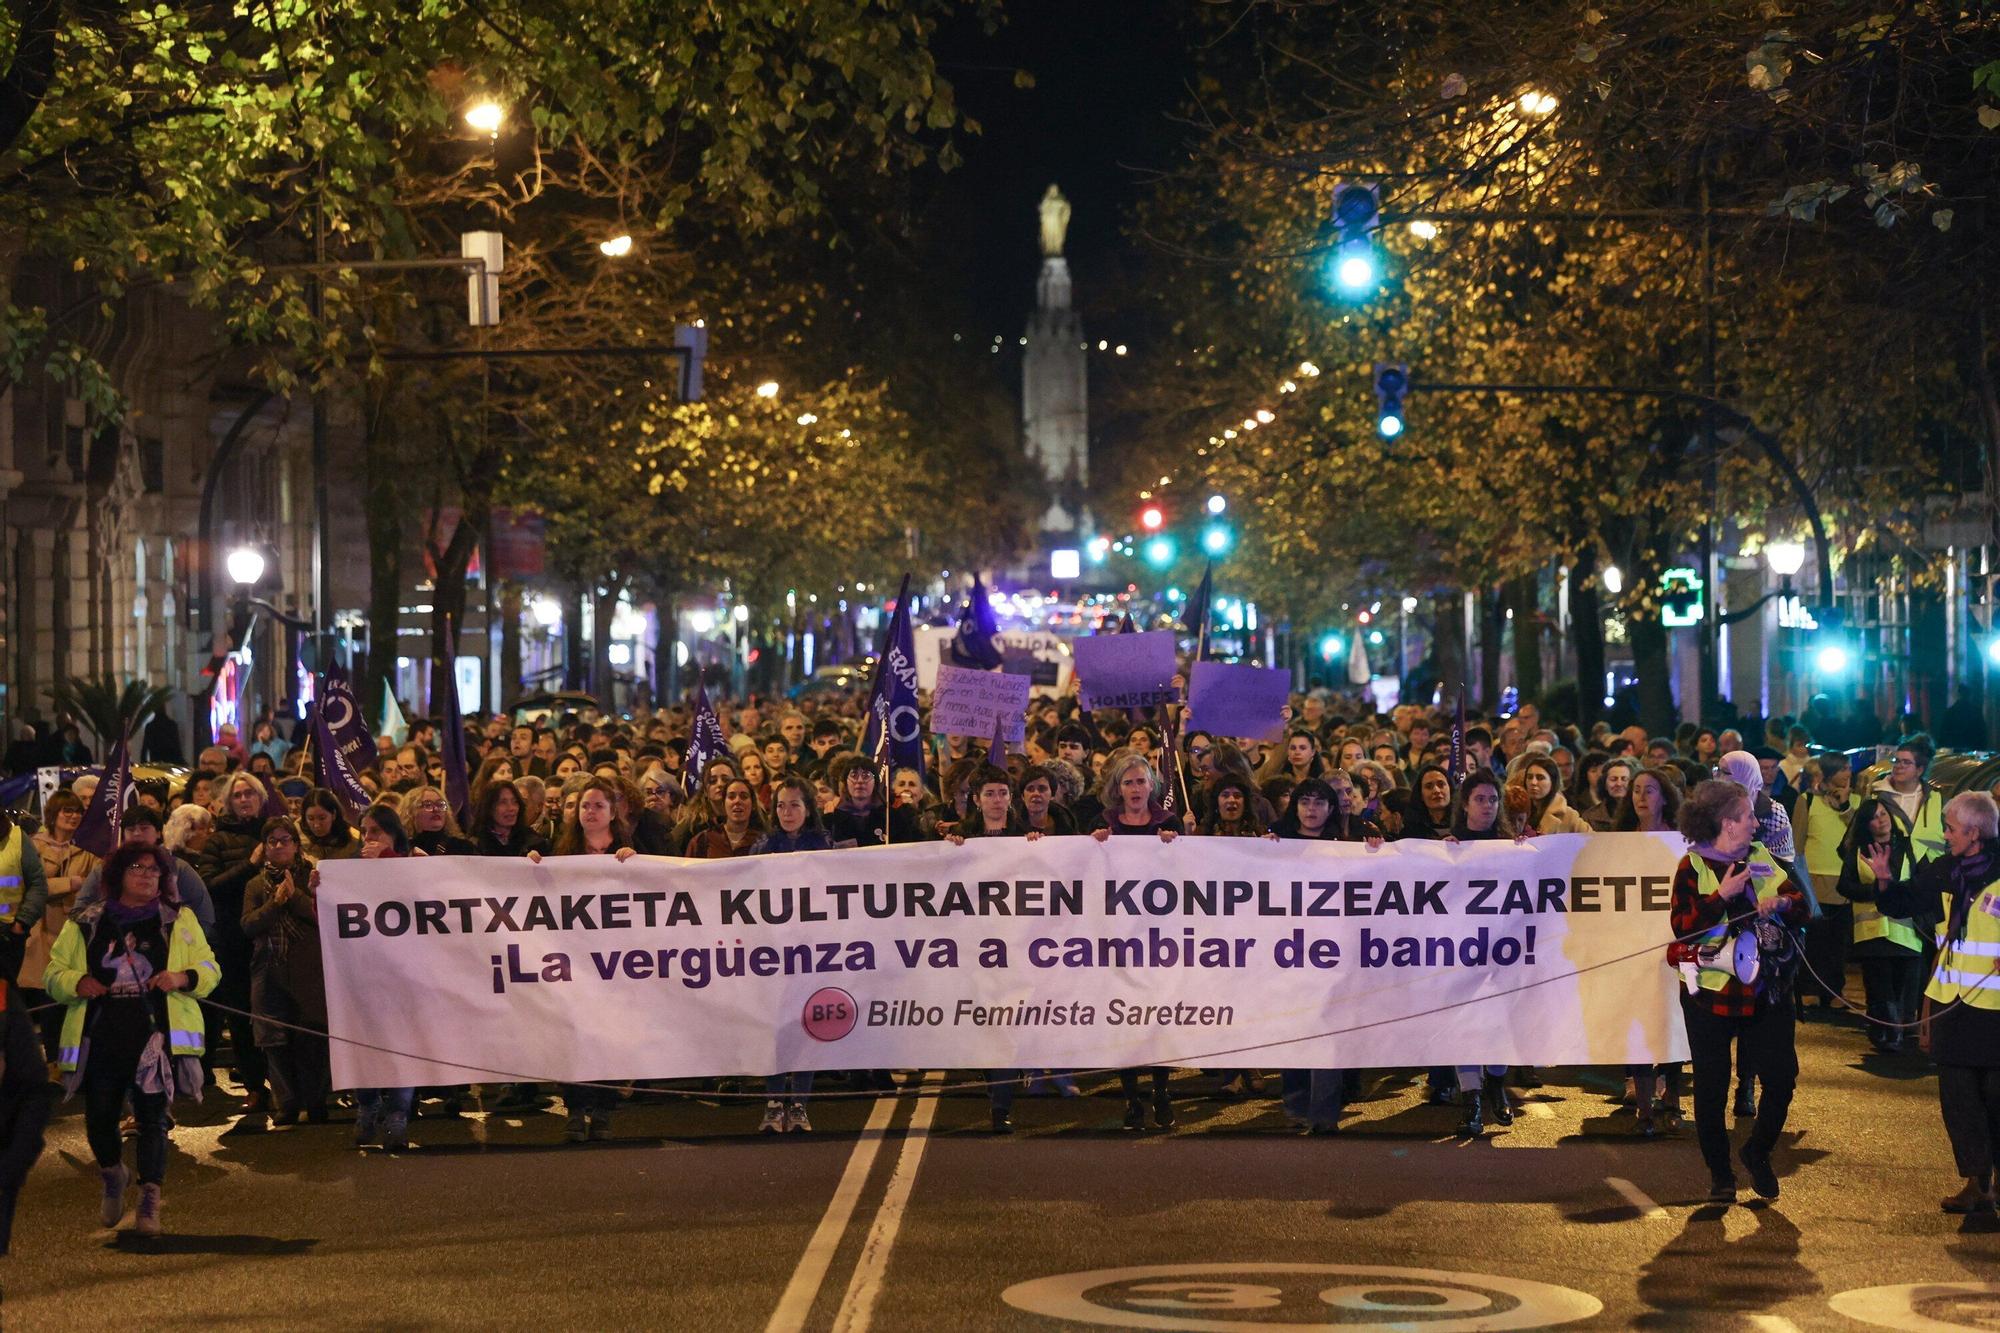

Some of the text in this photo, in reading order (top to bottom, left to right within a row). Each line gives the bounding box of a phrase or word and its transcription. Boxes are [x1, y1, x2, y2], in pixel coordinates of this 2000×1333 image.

[1089, 691, 1174, 707] HOMBRES
[336, 876, 1672, 939] BORTXAKETA KULTURAREN KONPLIZEAK ZARETE
[491, 925, 1537, 994] ¡La vergüenza va a cambiar de bando!
[811, 1002, 848, 1022] BFS
[867, 998, 1234, 1027] Bilbo Feminista Saretzen
[1126, 1282, 1492, 1312] 30
